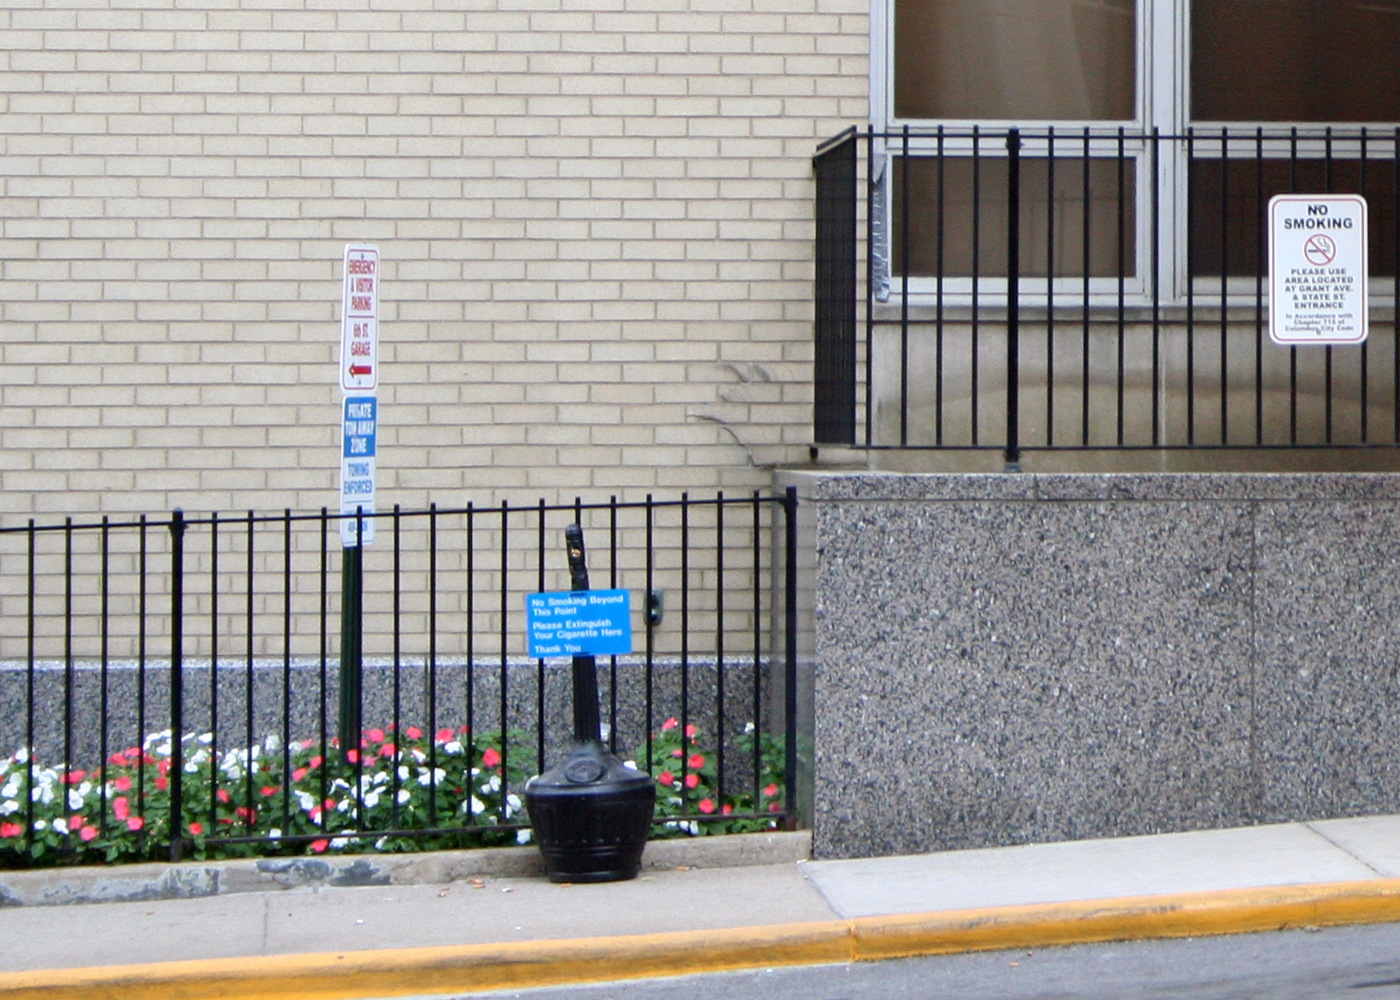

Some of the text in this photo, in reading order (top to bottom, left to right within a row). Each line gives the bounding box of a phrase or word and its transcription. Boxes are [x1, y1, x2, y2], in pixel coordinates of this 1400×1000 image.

[1307, 204, 1329, 216] NO
[1284, 218, 1353, 230] SMOKING
[349, 260, 375, 274] EMERGENCY
[356, 278, 373, 292] VISITOR
[351, 296, 372, 311] PARKING
[351, 341, 371, 356] GARAGE
[348, 403, 372, 418] PRIVATE
[357, 420, 375, 436] AWAY
[350, 437, 367, 453] ZONE
[348, 463, 369, 476] TOWING
[344, 480, 372, 494] ENFORCED
[532, 595, 623, 607] No Smoking Beyond
[533, 607, 576, 616] This Point
[533, 619, 611, 630] Please Extinguish
[534, 631, 553, 640] Your
[557, 630, 598, 639] Cigarette
[535, 644, 581, 653] Thank You
